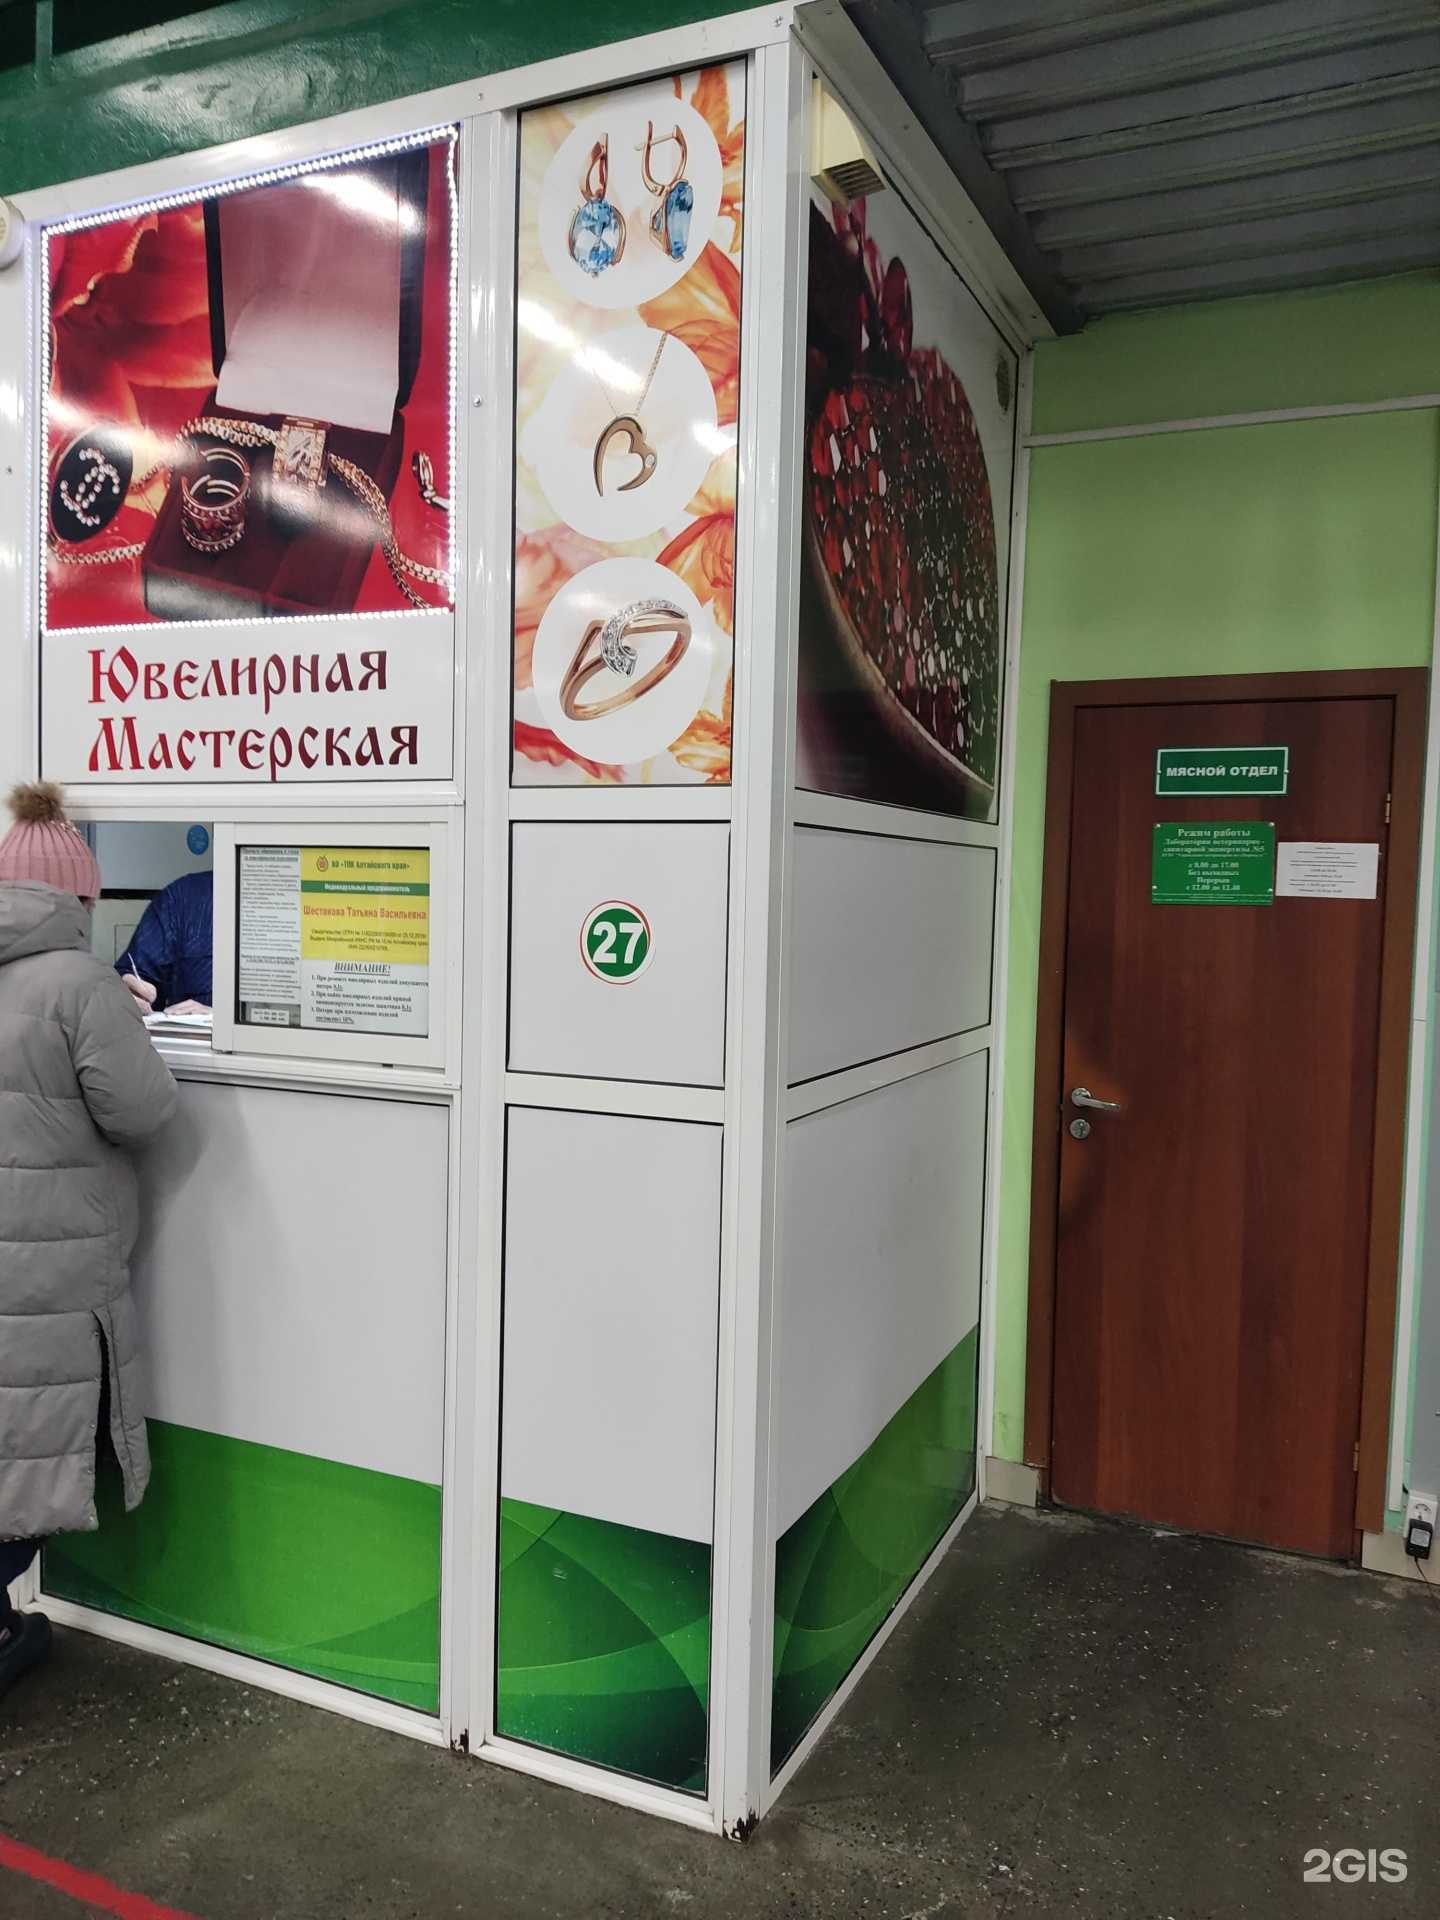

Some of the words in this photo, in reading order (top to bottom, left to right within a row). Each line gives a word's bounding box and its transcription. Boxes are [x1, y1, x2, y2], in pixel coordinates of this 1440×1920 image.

[88, 645, 387, 715] Ювелирная
[88, 716, 418, 782] Мастерская
[1166, 765, 1225, 776] МЯСНОЙ
[1230, 766, 1278, 777] ОТДЕЛ
[1177, 828, 1211, 837] Режим
[1213, 828, 1251, 838] работы
[347, 906, 378, 917] Татьяна
[380, 907, 426, 920] Васильевна
[592, 921, 644, 964] 27
[334, 962, 391, 974] ВНИМАНИЕ!
